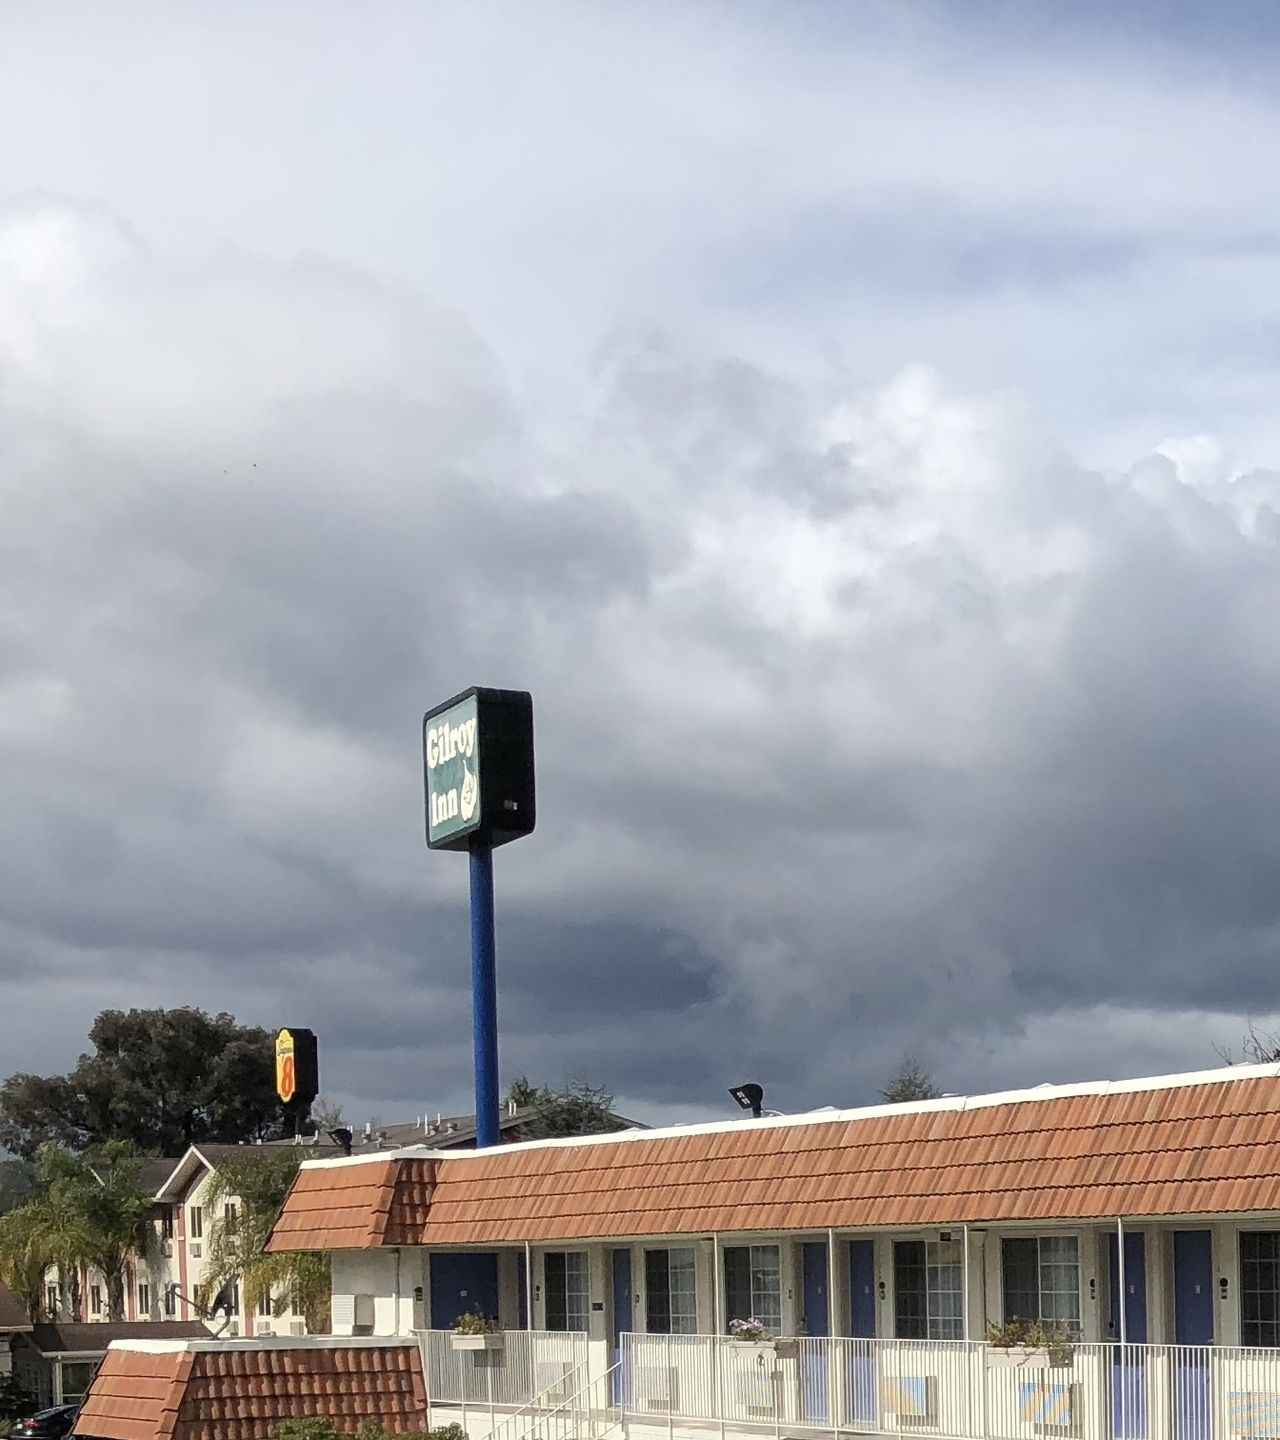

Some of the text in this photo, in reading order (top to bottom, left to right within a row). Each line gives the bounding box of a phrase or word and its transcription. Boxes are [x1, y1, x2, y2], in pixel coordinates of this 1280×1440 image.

[427, 717, 477, 769] Gilroy
[431, 787, 459, 827] Inn
[281, 1055, 294, 1098] 8
